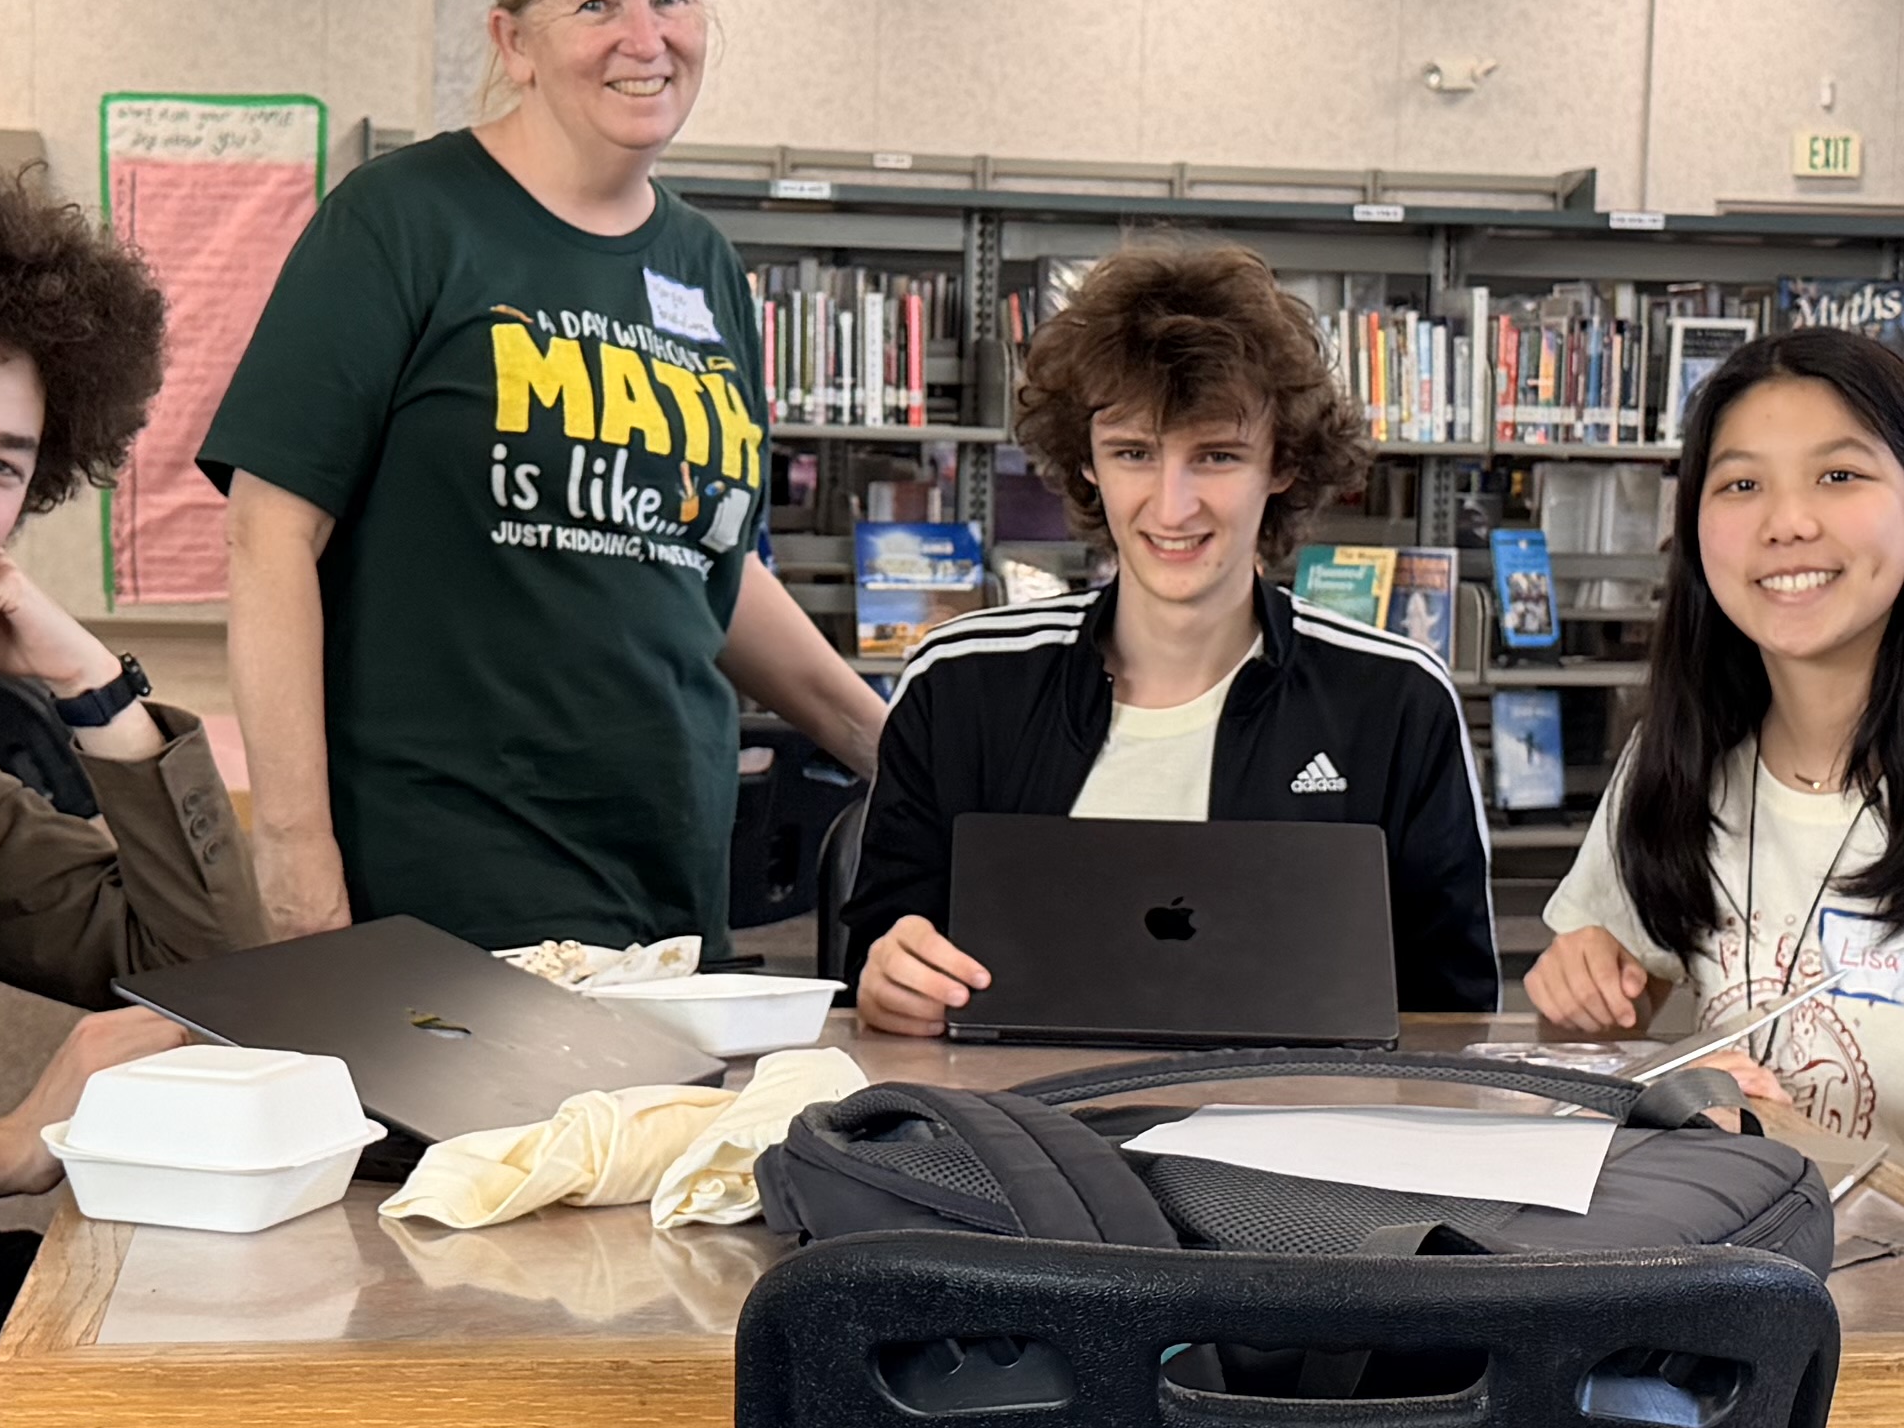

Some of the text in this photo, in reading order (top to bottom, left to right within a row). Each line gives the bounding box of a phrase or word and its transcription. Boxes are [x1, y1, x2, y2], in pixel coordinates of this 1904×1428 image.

[1809, 136, 1851, 170] EXIT
[1792, 284, 1902, 330] Myths
[536, 310, 707, 372] A DAY WITHOUT
[491, 323, 763, 489] MATH
[491, 443, 688, 537] is like...
[491, 521, 552, 549] JUST
[555, 525, 645, 562] KIDDING,
[1290, 777, 1348, 793] adidas
[1840, 937, 1900, 973] Lisa
